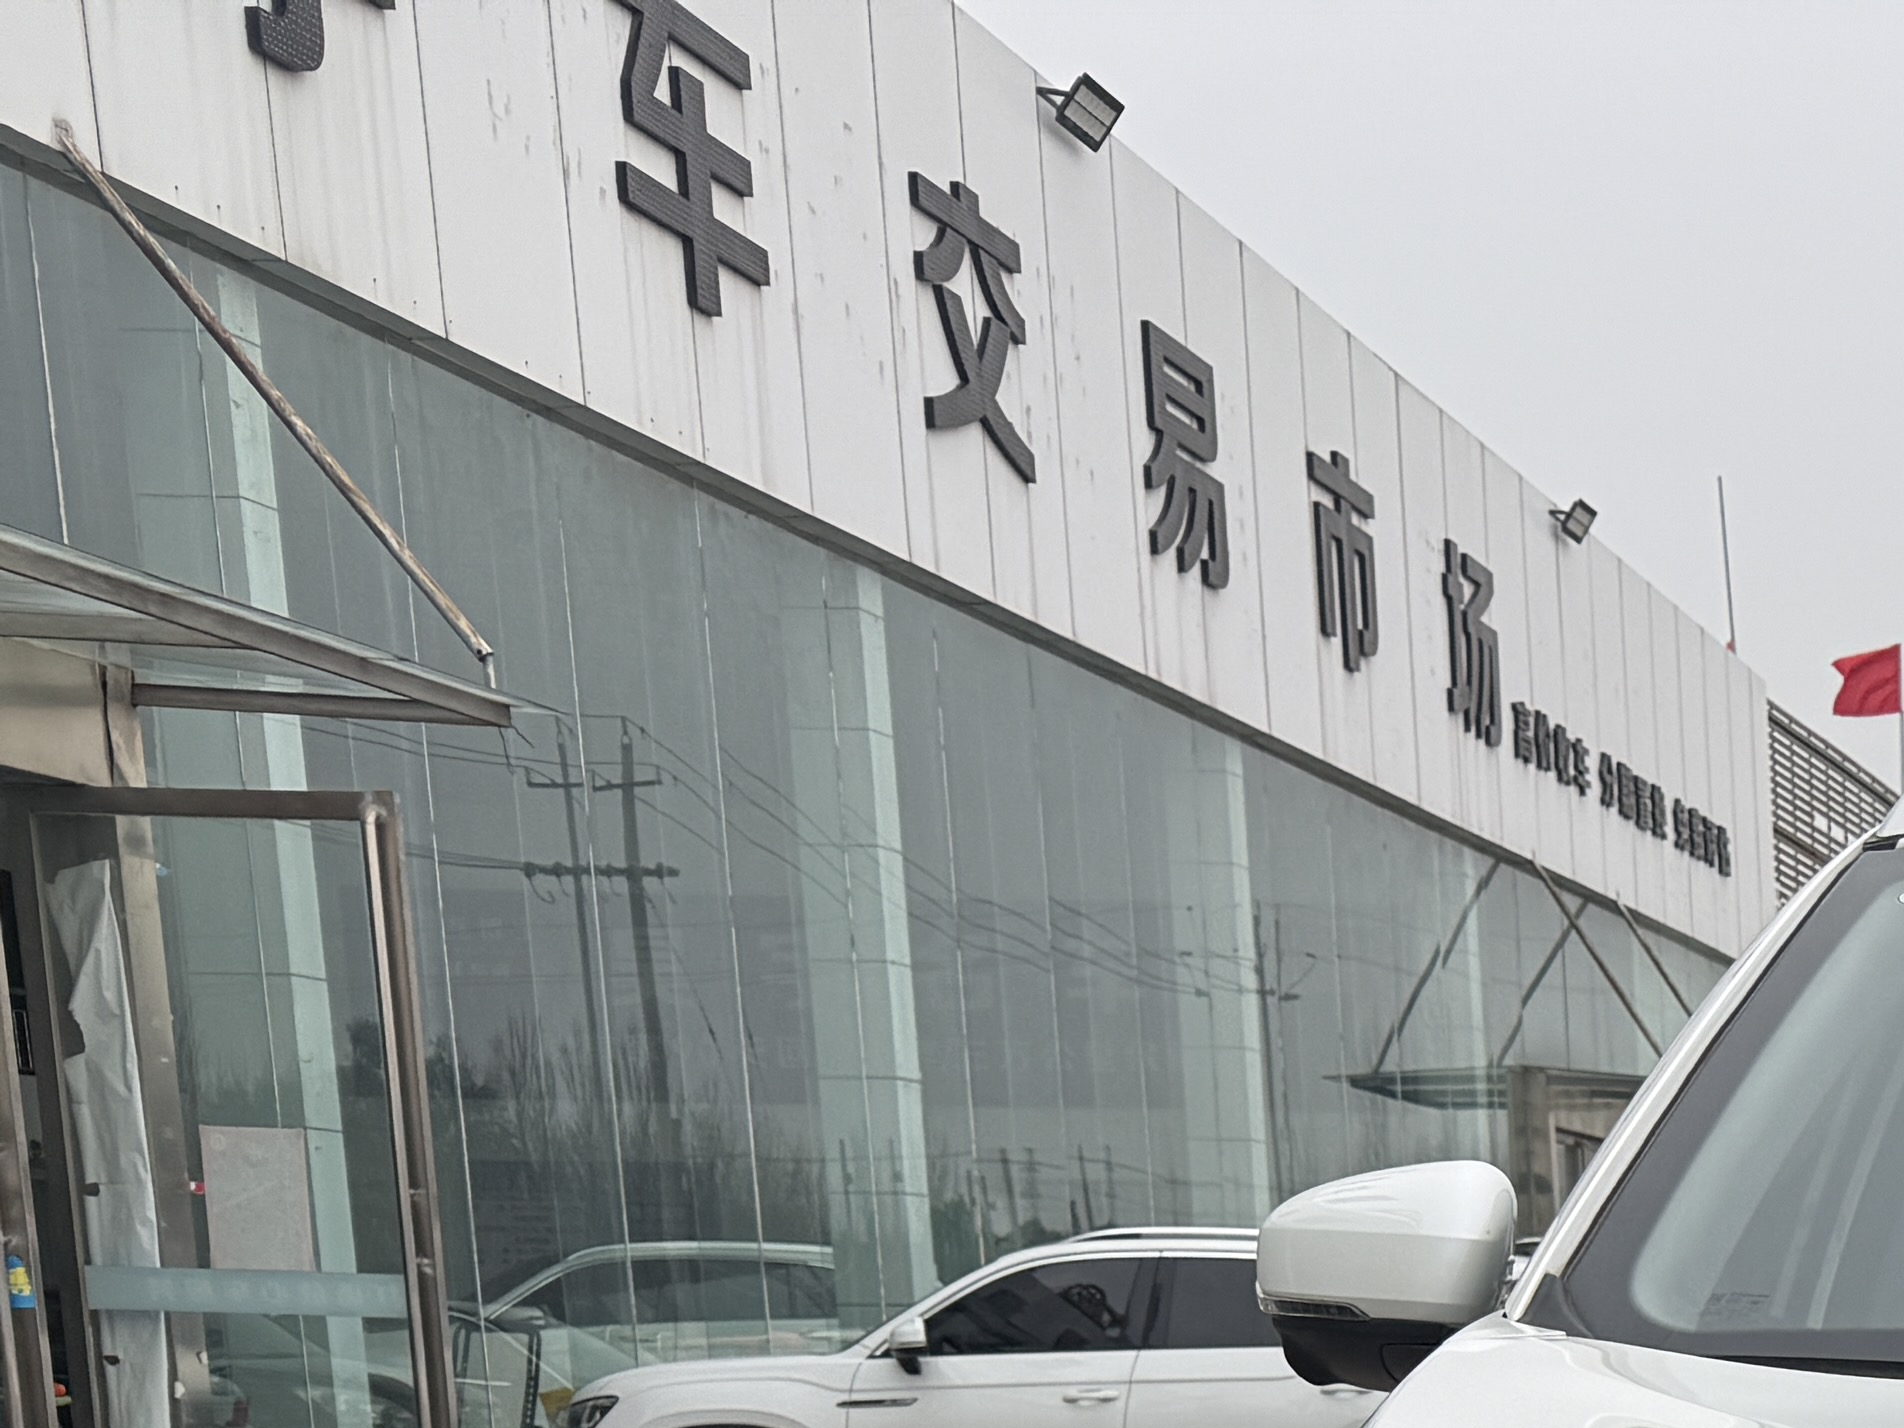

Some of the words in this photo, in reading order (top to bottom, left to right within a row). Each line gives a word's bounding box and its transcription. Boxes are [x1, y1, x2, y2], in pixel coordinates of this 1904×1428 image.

[244, 0, 1501, 747] 车交易市场
